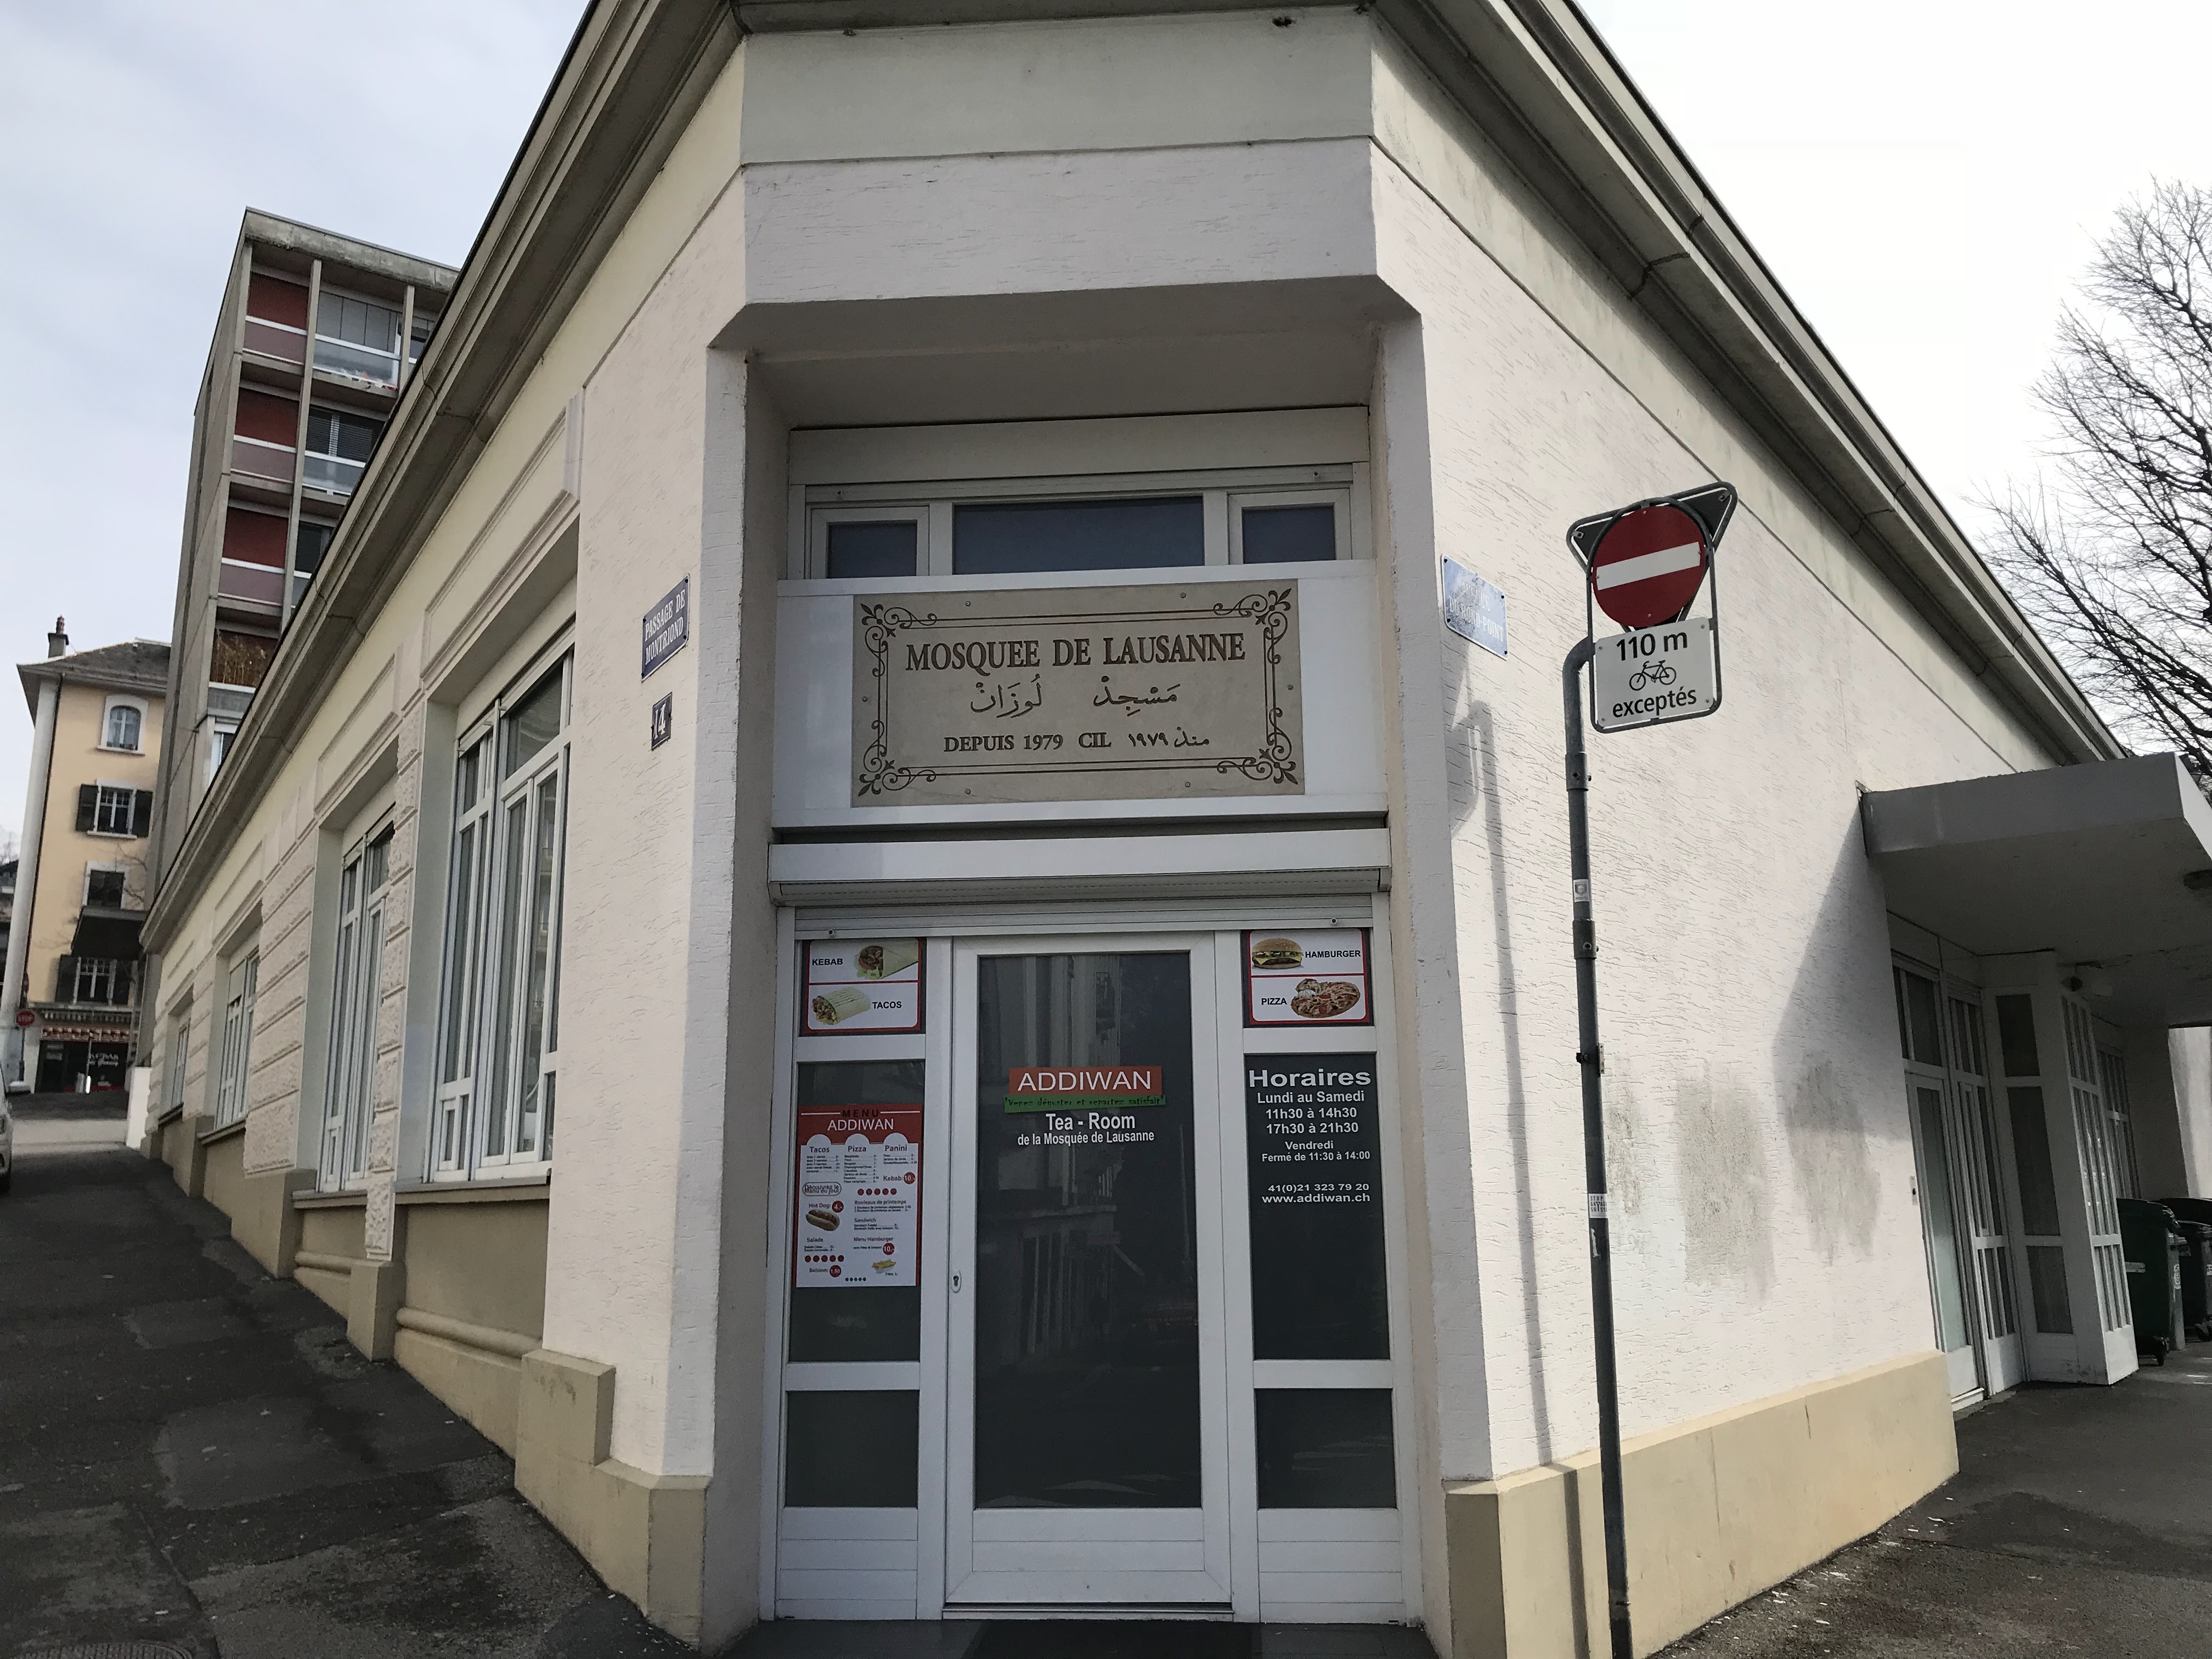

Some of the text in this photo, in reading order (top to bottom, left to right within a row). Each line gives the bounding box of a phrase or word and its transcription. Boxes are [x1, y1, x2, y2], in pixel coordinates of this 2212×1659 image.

[645, 589, 685, 641] PASSAGE DE
[1449, 596, 1504, 642] DU ROND-POINT
[645, 616, 684, 665] MONTRIOND
[1616, 631, 1688, 661] 110 m
[905, 633, 1246, 676] MOSQUEE DE LAUSANNE
[1612, 686, 1697, 718] exceptés
[654, 703, 666, 741] 14
[944, 732, 1111, 752] DEPUIS 1979 CIL
[1128, 732, 1169, 747] ١٩٧٩
[1305, 950, 1361, 958] HAMBURGER
[812, 958, 843, 966] KEBAB
[872, 1001, 902, 1009] TACOS
[1017, 1071, 1151, 1091] ADDIWAN
[1249, 1068, 1371, 1088] Horaires
[1257, 1090, 1365, 1104] Lundi au Samedi
[842, 1109, 879, 1118] MENU
[1266, 1107, 1357, 1119] 11h30 à 14h30
[827, 1118, 894, 1131] ADDIWAN
[1046, 1113, 1074, 1131] Tea
[1088, 1112, 1136, 1130] Room
[1266, 1122, 1359, 1134] 17h30 à 21h30
[1018, 1131, 1155, 1147] de la Mosquée de Lausanne
[1285, 1140, 1334, 1150] Vendredi
[1262, 1151, 1370, 1162] Fermé de 11:30 à 14:00
[1268, 1184, 1310, 1193] 41(0)21
[1262, 1193, 1370, 1203] www.addiwan.ch
